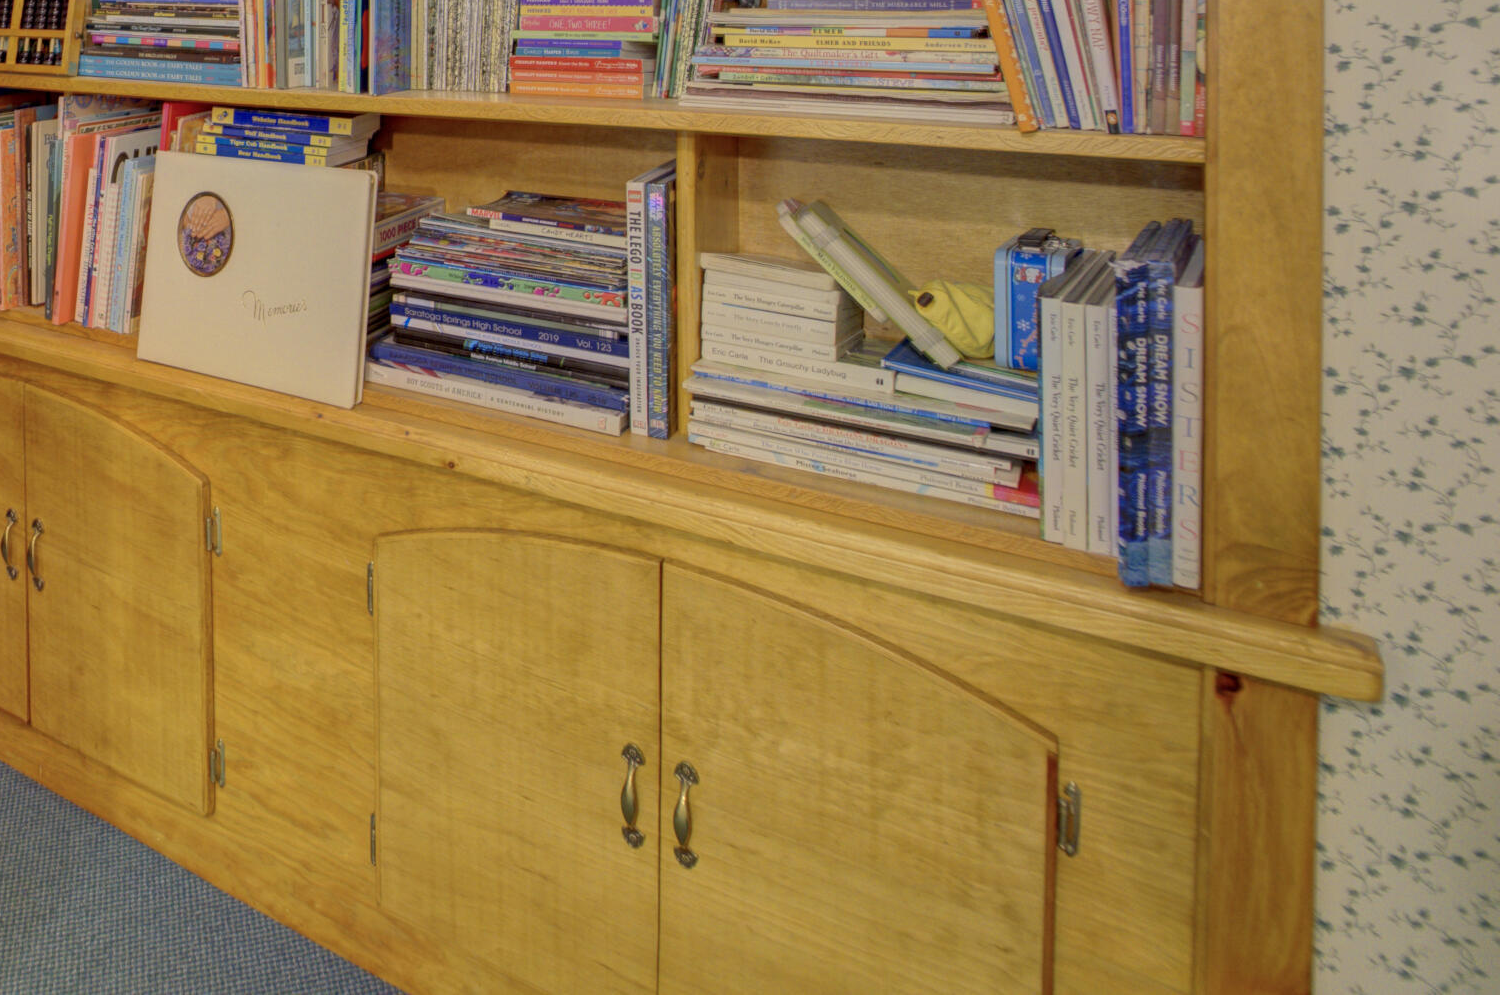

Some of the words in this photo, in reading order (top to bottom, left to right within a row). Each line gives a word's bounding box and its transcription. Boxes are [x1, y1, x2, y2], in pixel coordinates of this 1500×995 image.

[1028, 6, 1050, 52] presents?
[1090, 27, 1107, 51] NAP
[782, 48, 798, 56] The
[800, 48, 858, 59] Quiltmaker's
[278, 117, 309, 127] Handbook
[230, 139, 245, 147] Tiger
[246, 140, 257, 148] Cub
[258, 141, 288, 151] Handbook
[258, 131, 287, 140] Handbook
[252, 151, 282, 160] Handbook
[471, 208, 500, 220] MARVEL
[629, 210, 642, 235] THE
[379, 228, 396, 242] 1000
[397, 219, 418, 235] PIECE
[541, 227, 563, 237] CANDY
[565, 230, 594, 241] HEARTS
[629, 235, 642, 264] LEGO
[652, 225, 662, 277] ABSOLUTELY
[630, 268, 643, 300] IDEAS
[1137, 281, 1146, 298] Eric
[1156, 279, 1168, 295] Eric
[243, 290, 308, 326] Memories
[652, 278, 662, 331] EVERYTHING
[744, 295, 756, 303] Very
[756, 296, 776, 306] Hungry
[777, 300, 804, 311] Caterpillar
[1137, 300, 1146, 323] Carle
[1156, 297, 1167, 320] Carle
[404, 307, 442, 322] Saratoga
[443, 314, 472, 328] Springs
[472, 318, 491, 331] High
[493, 323, 522, 336] School
[538, 332, 560, 343] 2019
[576, 338, 594, 349] Vol.
[597, 342, 613, 353] 123
[631, 304, 644, 334] BOOK
[1067, 318, 1075, 329] Eric
[522, 340, 542, 350] SCHOOL
[653, 332, 663, 349] YOU
[732, 333, 741, 341] The
[742, 335, 754, 344] Very
[754, 337, 774, 347] Hungry
[775, 340, 803, 352] Caterpillar
[1050, 326, 1058, 342] Carle
[1067, 331, 1075, 346] Carle
[1093, 333, 1101, 349] Carle
[653, 352, 662, 374] NEED
[711, 347, 726, 356] Eric
[728, 350, 749, 360] Carle
[759, 356, 774, 366] The
[776, 358, 810, 373] Grouchy
[812, 365, 847, 380] Ladybug
[1136, 337, 1147, 383] DREAM
[1155, 334, 1168, 380] DREAM
[389, 350, 429, 365] SARATOGA
[431, 358, 463, 372] SPRINGS
[464, 365, 484, 377] HIGH
[486, 369, 517, 385] SCHOOL
[529, 380, 561, 395] VOLUME
[653, 375, 662, 387] TO
[1052, 374, 1061, 390] The
[406, 376, 418, 386] BOY
[420, 379, 443, 391] SCOUTS
[451, 385, 482, 399] AMERICA
[1069, 377, 1078, 392] The
[1096, 383, 1105, 397] The
[496, 397, 535, 411] CENTENNIAL
[537, 405, 565, 418] HISTORY
[653, 388, 663, 413] KNOW
[1050, 392, 1060, 408] Very
[1067, 396, 1077, 412] Very
[1095, 401, 1104, 416] Very
[1135, 386, 1147, 428] SNOW
[1155, 383, 1169, 426] SNOW
[1050, 411, 1061, 431] Quiet
[1066, 415, 1078, 437] Quiet
[1094, 420, 1106, 441] Quiet
[1176, 312, 1200, 542] SISTERS
[1052, 433, 1061, 461] Cricket
[1068, 439, 1077, 468] Cricket
[1096, 443, 1107, 471] Cricket
[723, 442, 740, 452] Carle
[796, 460, 821, 471] Mister
[823, 464, 857, 478] Seahorse
[967, 496, 999, 509] Philomel
[1001, 503, 1027, 515] Books
[844, 457, 859, 467] Blue
[861, 461, 882, 471] Horse
[920, 475, 953, 487] Philomel
[954, 482, 978, 492] Books
[1137, 473, 1147, 509] Philomel
[1156, 470, 1166, 507] Philomel
[1136, 511, 1146, 536] Books
[1156, 508, 1167, 533] Books
